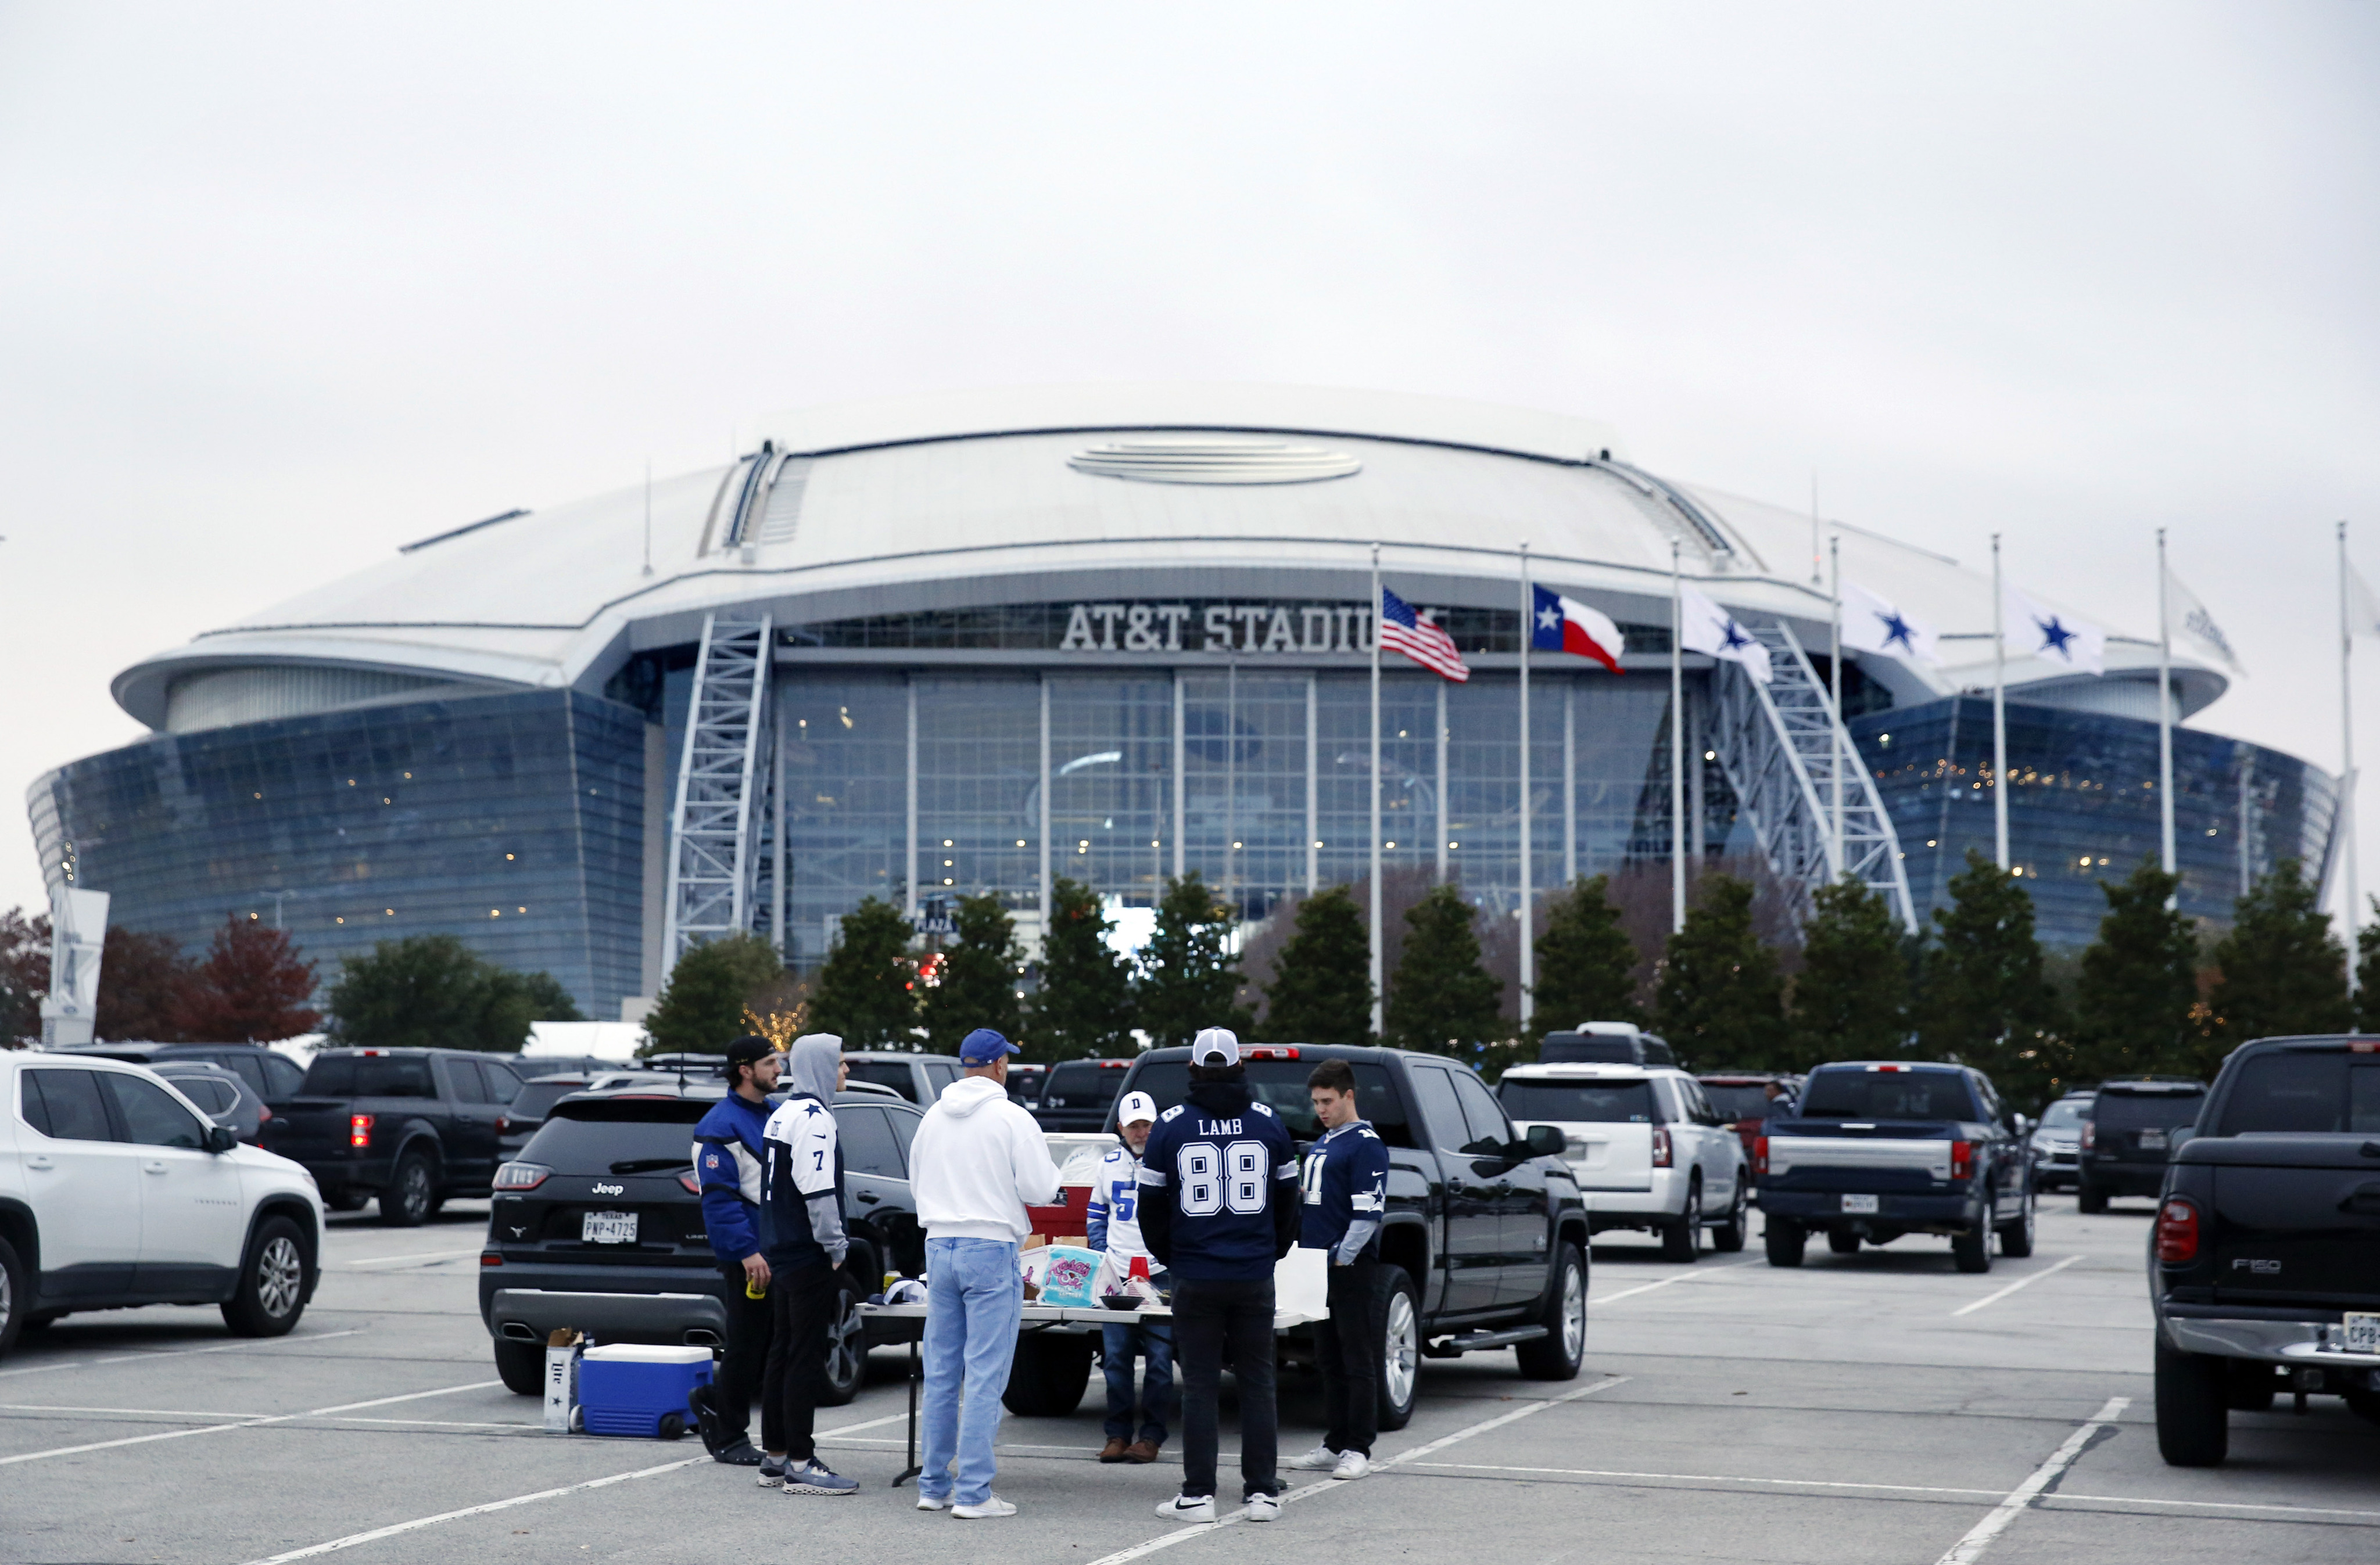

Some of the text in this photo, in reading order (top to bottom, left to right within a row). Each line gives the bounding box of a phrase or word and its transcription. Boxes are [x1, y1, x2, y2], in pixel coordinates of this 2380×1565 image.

[1060, 605, 1450, 653] AT&T STADI
[1132, 1098, 1140, 1109] D
[1198, 1118, 1243, 1136] LAMB
[813, 1150, 823, 1171] 7
[1177, 1140, 1269, 1217] 88
[1303, 1154, 1328, 1205] 11
[592, 1182, 624, 1197] Jeep
[1112, 1180, 1138, 1221] 5
[2350, 1326, 2380, 1344] CPB
[551, 1363, 564, 1384] Lite
